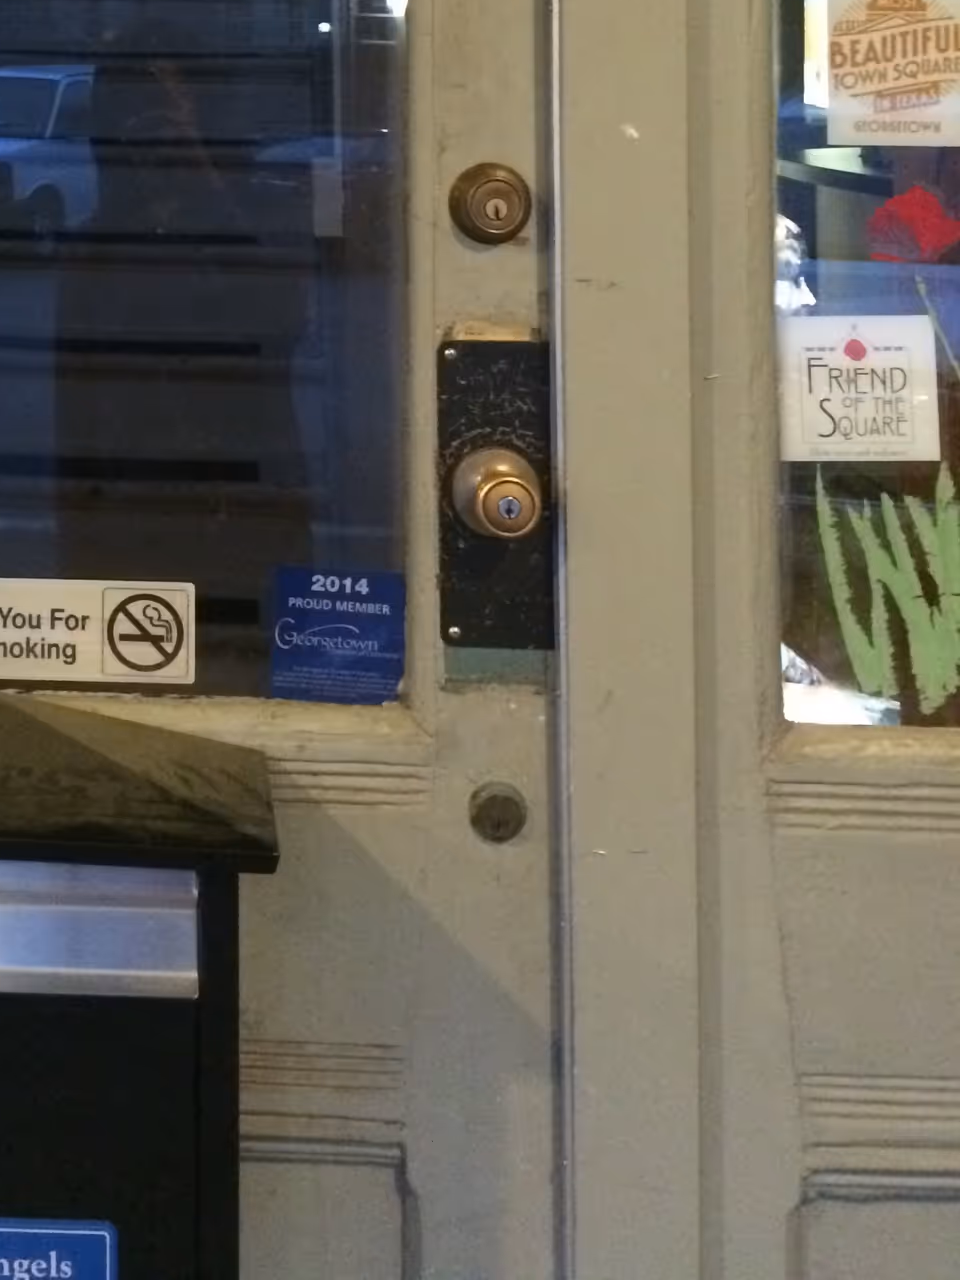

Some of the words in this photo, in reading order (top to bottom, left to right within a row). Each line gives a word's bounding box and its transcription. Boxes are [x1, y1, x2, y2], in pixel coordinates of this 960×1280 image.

[830, 23, 960, 70] BEAUTIFUL
[832, 66, 888, 91] TOWN
[807, 357, 908, 395] FRIEND
[841, 396, 865, 415] OF
[873, 397, 906, 416] THE
[817, 398, 909, 440] SQUARE
[310, 574, 370, 595] 2014
[287, 596, 333, 611] PROUD
[335, 600, 391, 616] MEMBER
[48, 609, 91, 633] For
[274, 617, 379, 651] Georgetown
